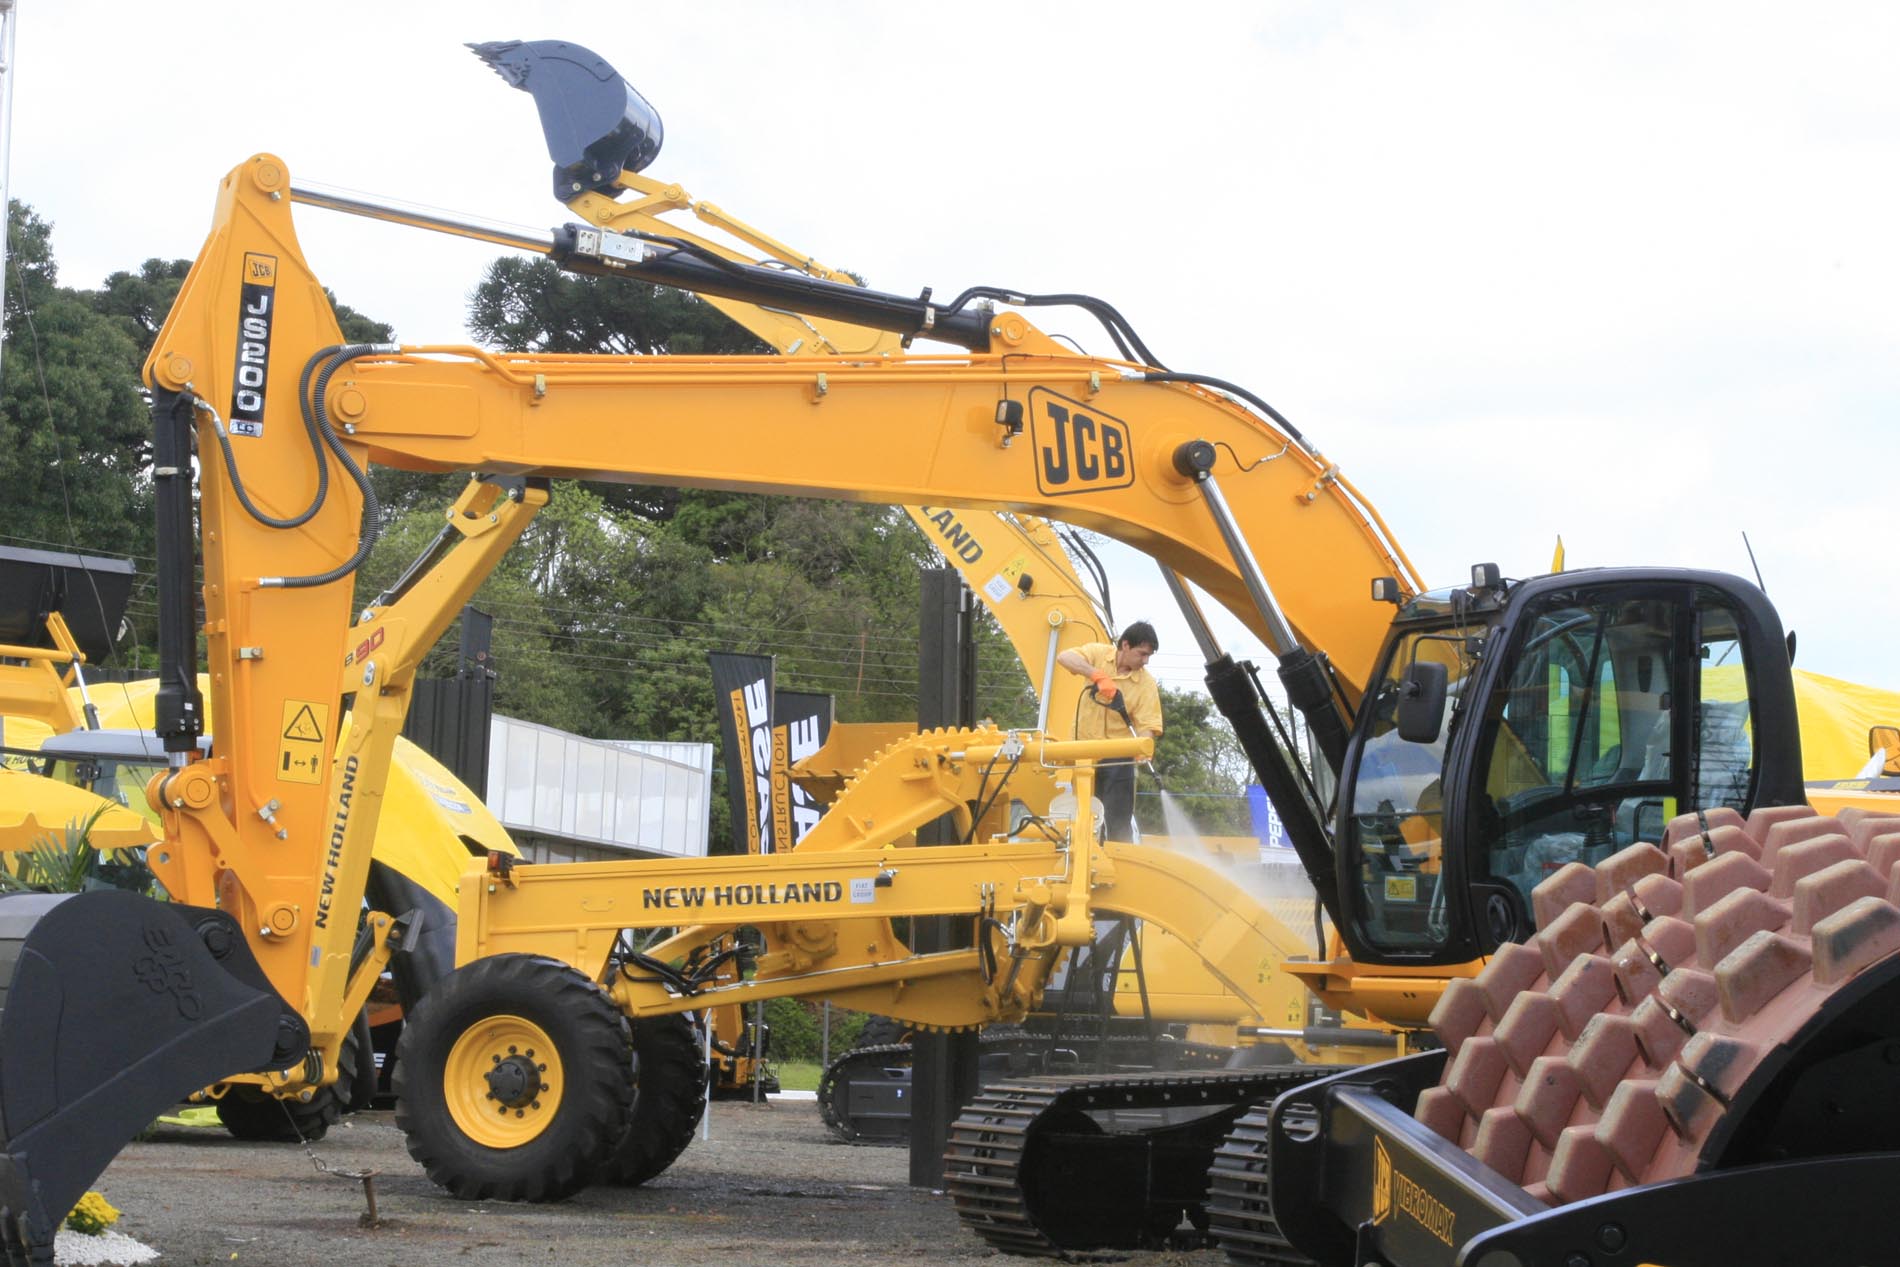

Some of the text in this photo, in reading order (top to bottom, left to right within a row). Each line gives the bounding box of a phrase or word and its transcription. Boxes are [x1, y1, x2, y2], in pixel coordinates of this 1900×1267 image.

[251, 261, 273, 278] JCB
[236, 295, 268, 412] JS200
[1042, 401, 1126, 486] JCB
[315, 755, 360, 929] NEW HOLLAND
[642, 881, 842, 909] NEW HOLLAND
[1393, 1169, 1455, 1248] VIBROMAX
